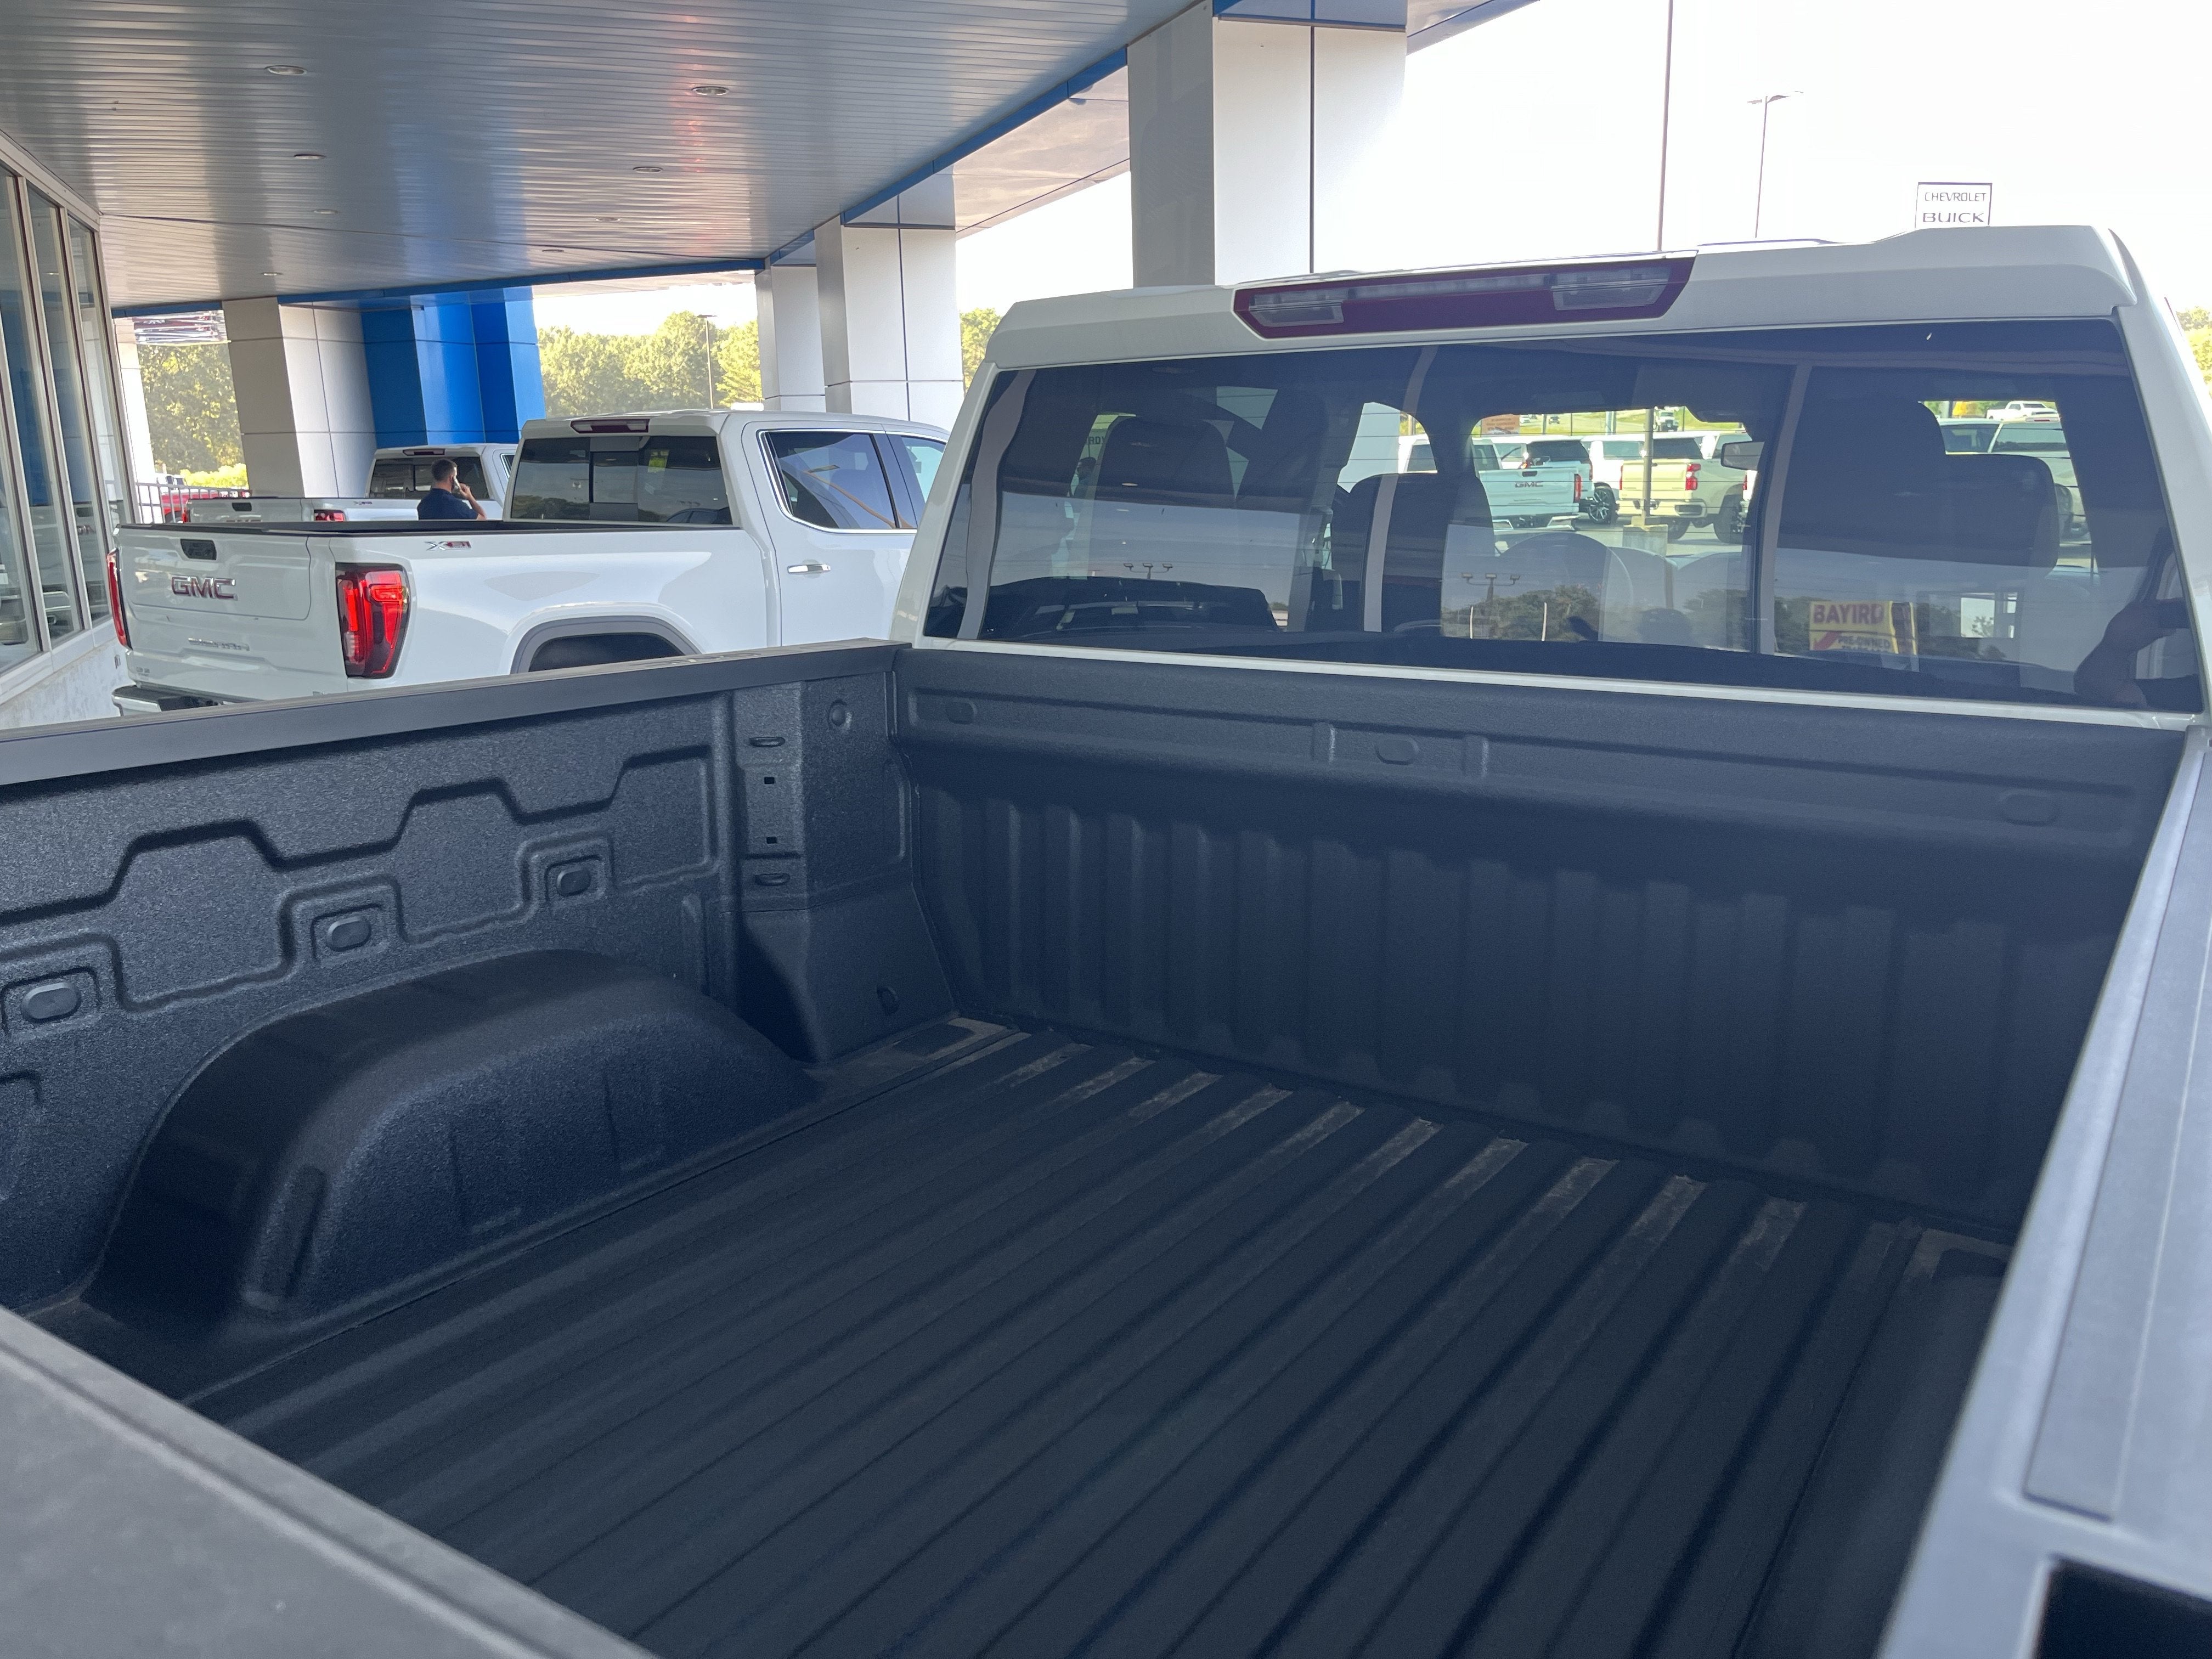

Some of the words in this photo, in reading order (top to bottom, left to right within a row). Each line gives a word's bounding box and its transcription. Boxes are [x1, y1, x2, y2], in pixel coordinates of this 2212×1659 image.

[1925, 192, 1987, 201] CHEVROLET
[1922, 212, 1984, 223] BUICK
[171, 575, 238, 601] GMC
[1813, 604, 1884, 624] BAYIRD
